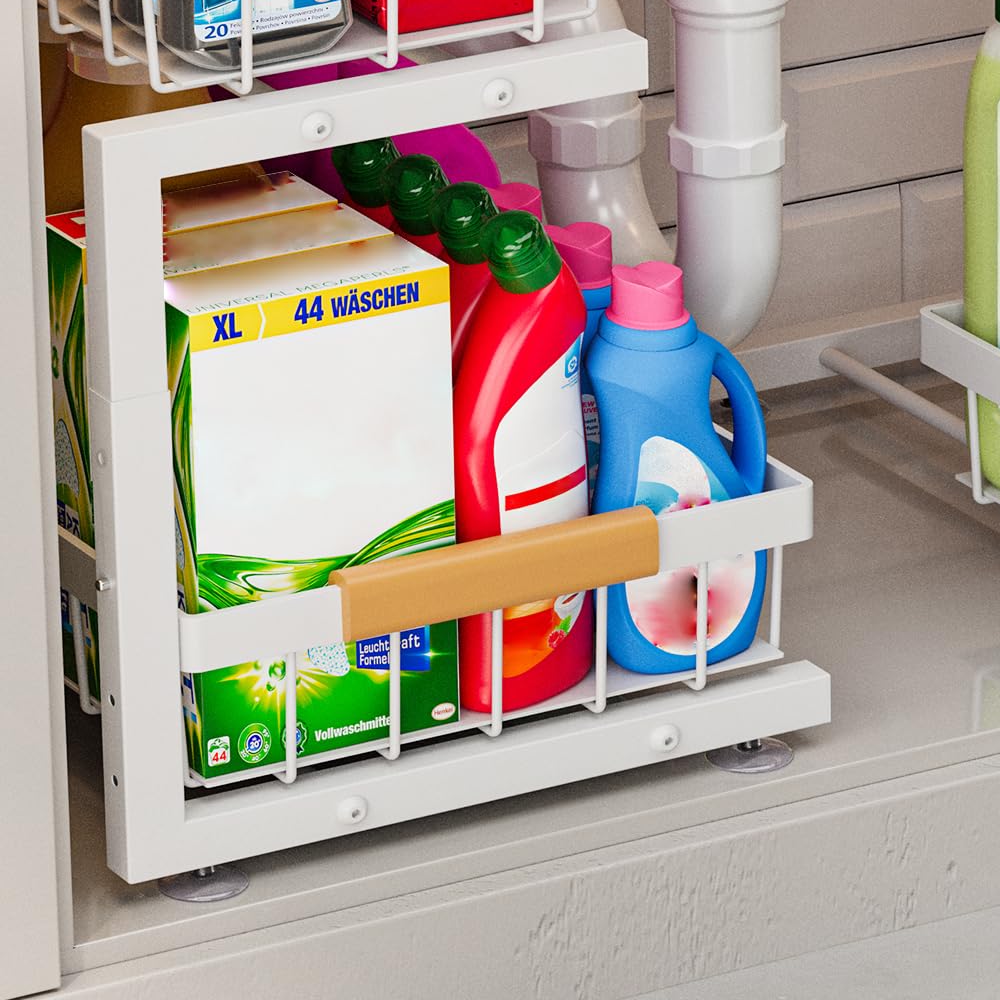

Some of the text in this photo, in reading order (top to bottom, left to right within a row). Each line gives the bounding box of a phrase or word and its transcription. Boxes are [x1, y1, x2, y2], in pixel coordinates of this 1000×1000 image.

[204, 23, 229, 40] 20
[293, 280, 420, 325] 44 WÄSCHEN
[212, 311, 243, 342] XL
[212, 750, 227, 764] 44
